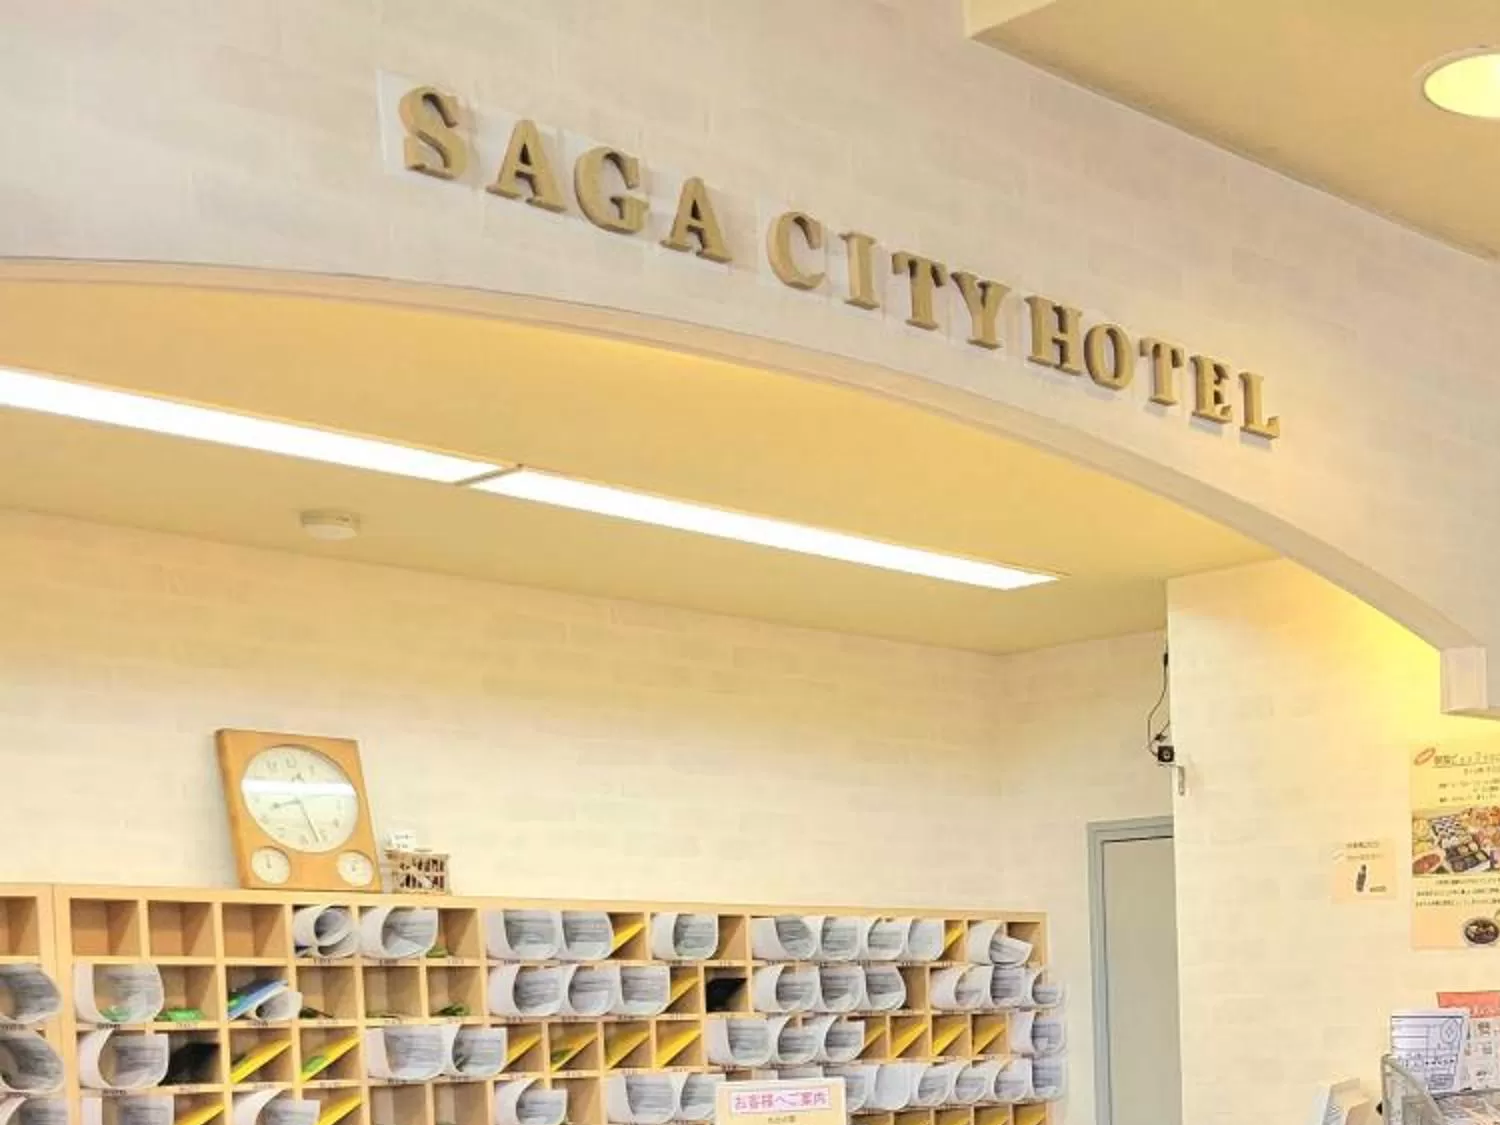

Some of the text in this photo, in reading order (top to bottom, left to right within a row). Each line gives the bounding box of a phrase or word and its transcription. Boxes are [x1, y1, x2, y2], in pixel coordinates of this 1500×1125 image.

[399, 84, 1282, 441] SAGA CITY HOTEL
[734, 1090, 827, 1111] お客様へご案内
